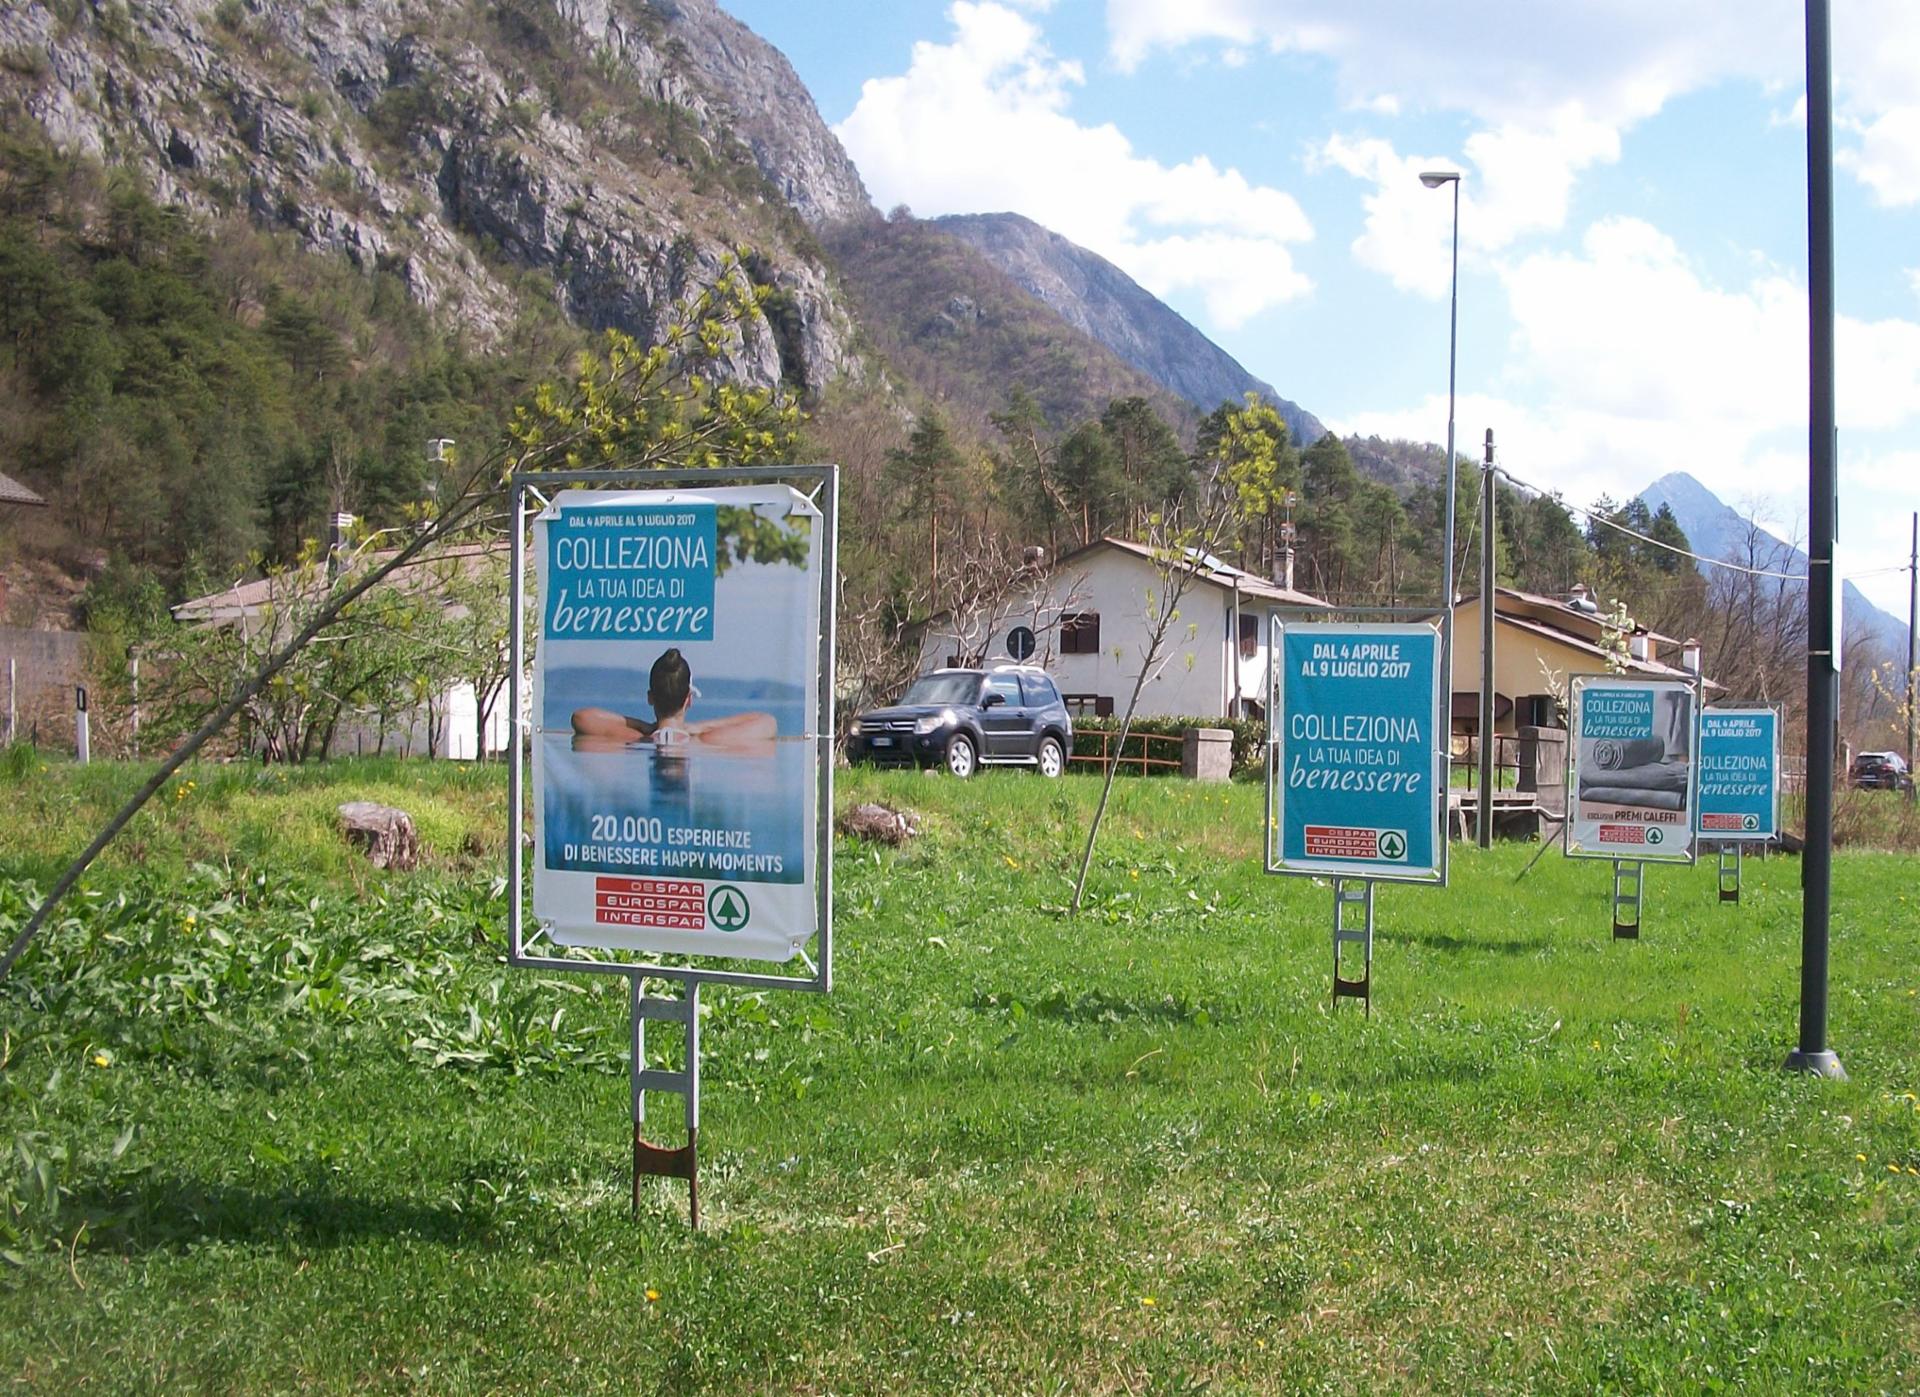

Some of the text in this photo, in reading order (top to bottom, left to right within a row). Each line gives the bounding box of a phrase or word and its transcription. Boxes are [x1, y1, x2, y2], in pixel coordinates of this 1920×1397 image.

[569, 513, 696, 528] DAL 4 APRILE AL 9 LUGLIO 2017
[556, 536, 709, 570] COLLEZIONA
[577, 577, 684, 599] LA TUA IDEA DI
[552, 588, 708, 633] benessere
[1313, 643, 1400, 661] DAL 4 APRILE
[1301, 660, 1412, 679] AL 9 LUGLIO 2017
[1586, 699, 1651, 714] COLLEZIONA
[1291, 713, 1421, 744] COLLEZIONA
[1584, 718, 1650, 737] benessere
[1707, 719, 1721, 728] DAL
[1309, 747, 1400, 766] LA TUA IDEA DI
[1290, 754, 1422, 794] benessere
[1615, 810, 1642, 822] PREMI
[591, 814, 752, 849] 20.000 ESPERIENZE
[1312, 836, 1377, 848] EUROSPAR
[564, 843, 784, 873] DI BENESSERE HAPPY MOMENTS
[1310, 846, 1377, 858] INTERSPAR
[631, 882, 704, 896] DESPAR
[606, 896, 705, 912] EUROSPAR
[603, 911, 705, 928] INTERSPAR
